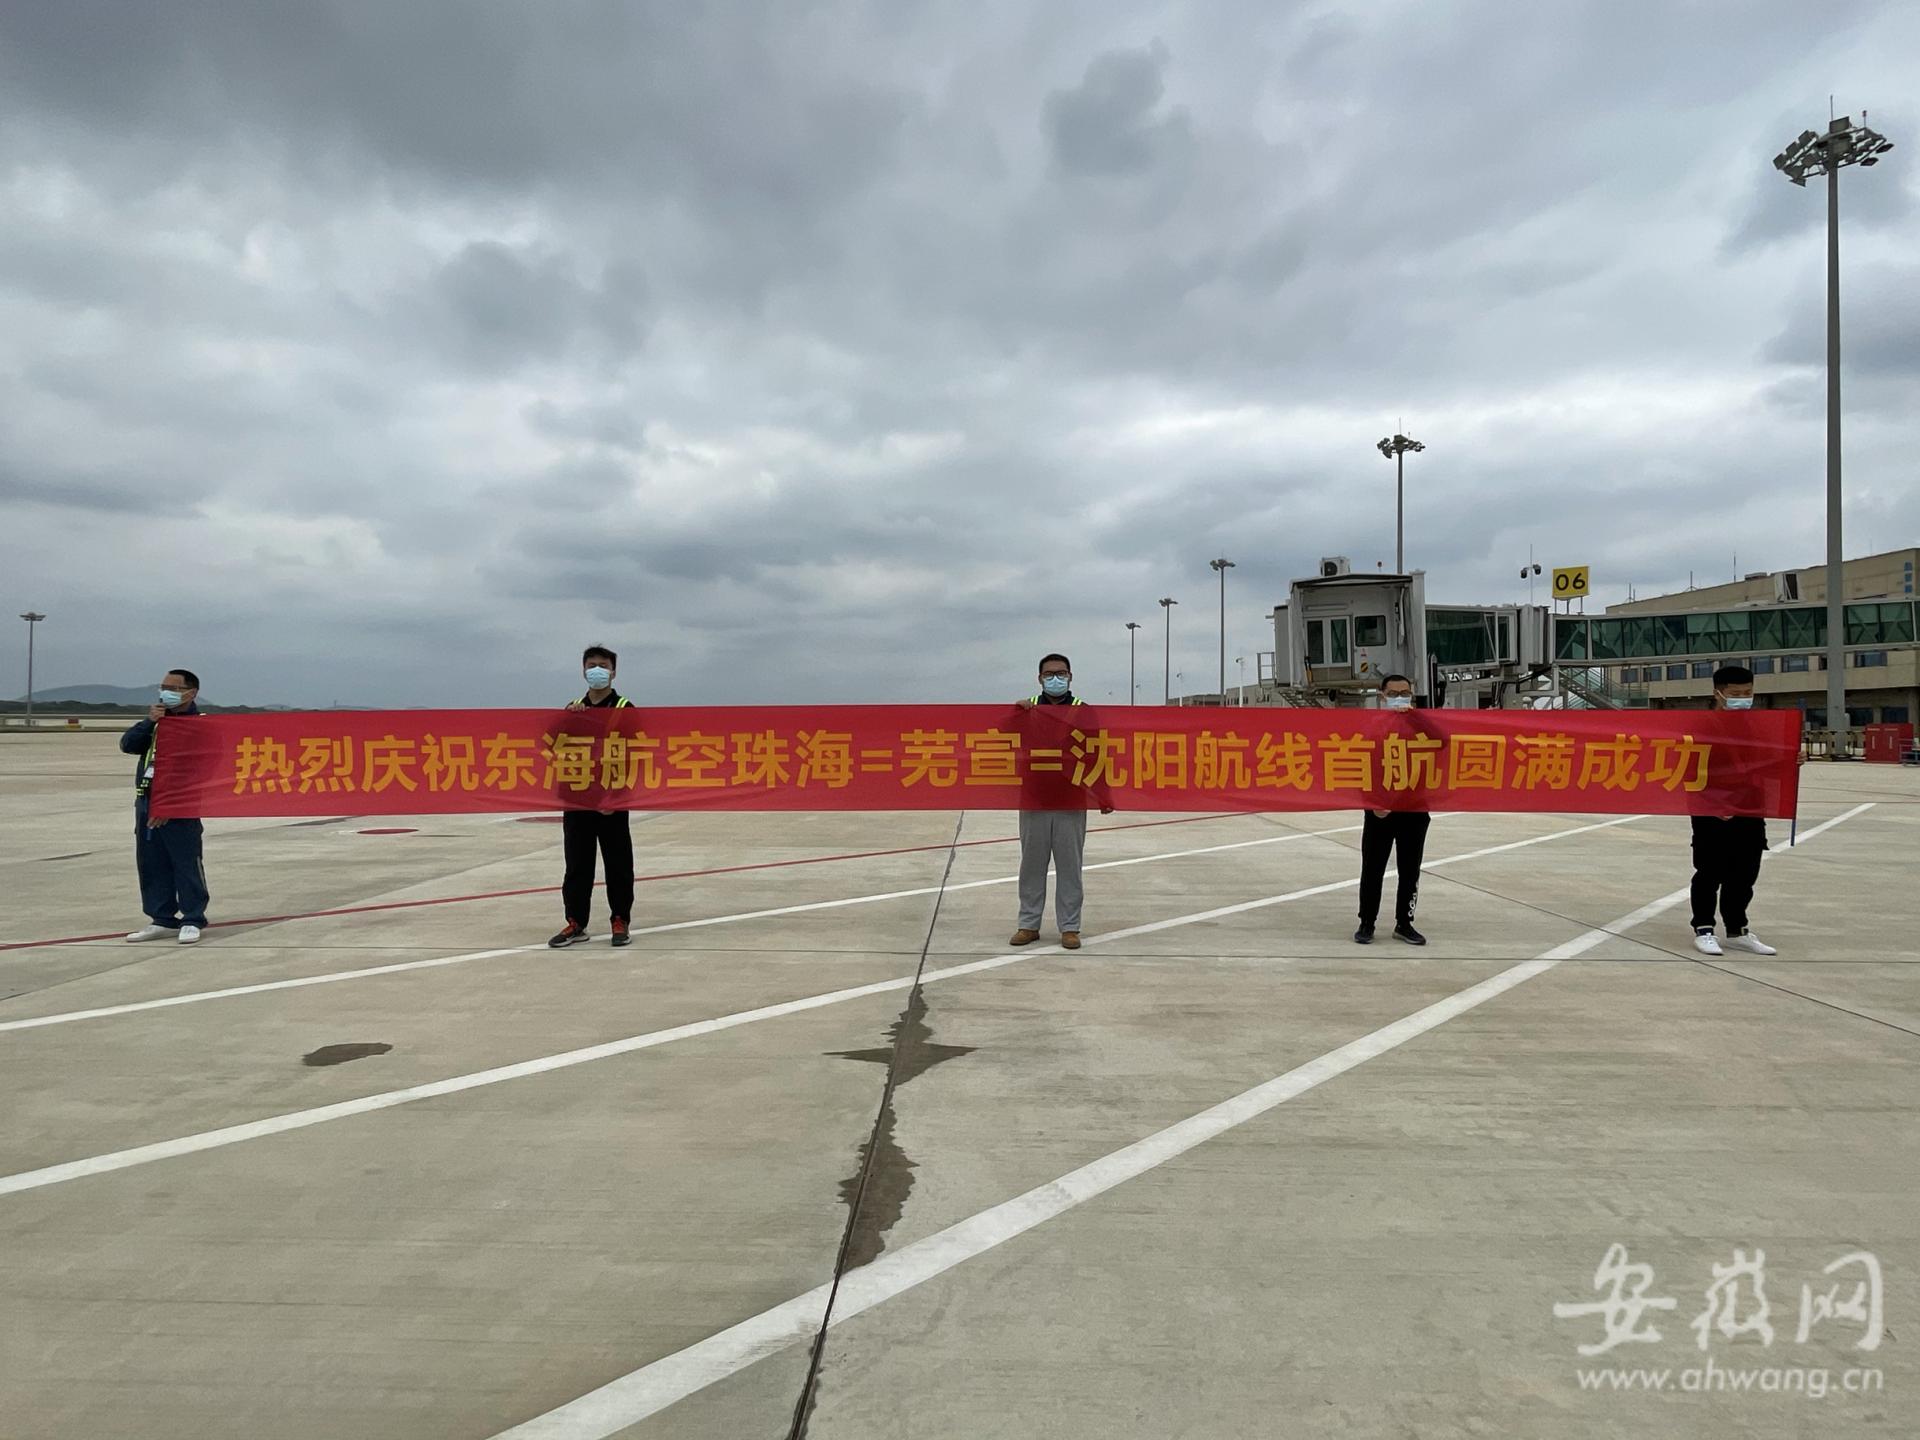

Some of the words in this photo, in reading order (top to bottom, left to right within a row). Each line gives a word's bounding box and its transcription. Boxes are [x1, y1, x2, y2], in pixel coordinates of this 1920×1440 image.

[1555, 572, 1586, 591] 06
[234, 728, 1710, 793] 热烈庆祝东海航空珠海=芜宣=沈阳航线首航圆满成功
